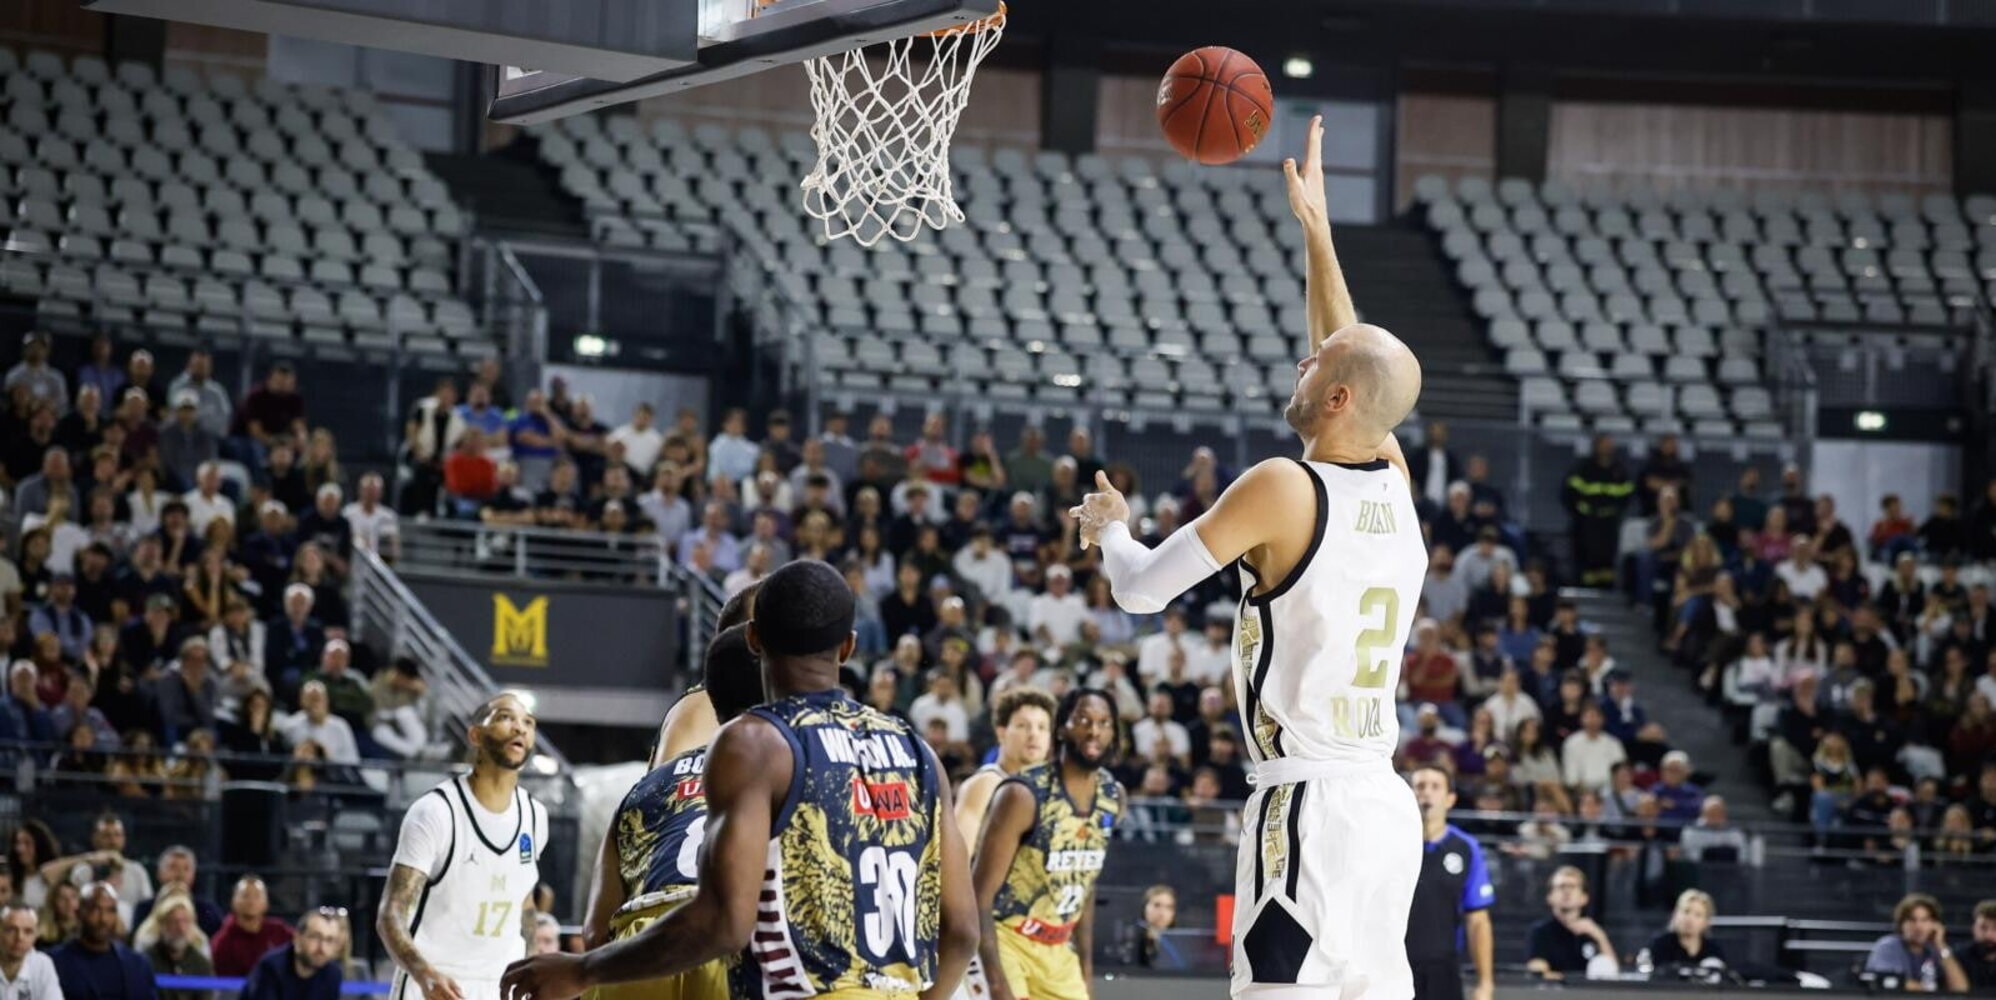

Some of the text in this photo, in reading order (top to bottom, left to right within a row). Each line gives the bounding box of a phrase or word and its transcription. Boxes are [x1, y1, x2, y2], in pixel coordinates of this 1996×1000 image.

[1351, 586, 1400, 689] 2
[473, 902, 512, 937] 17
[858, 846, 918, 960] 30
